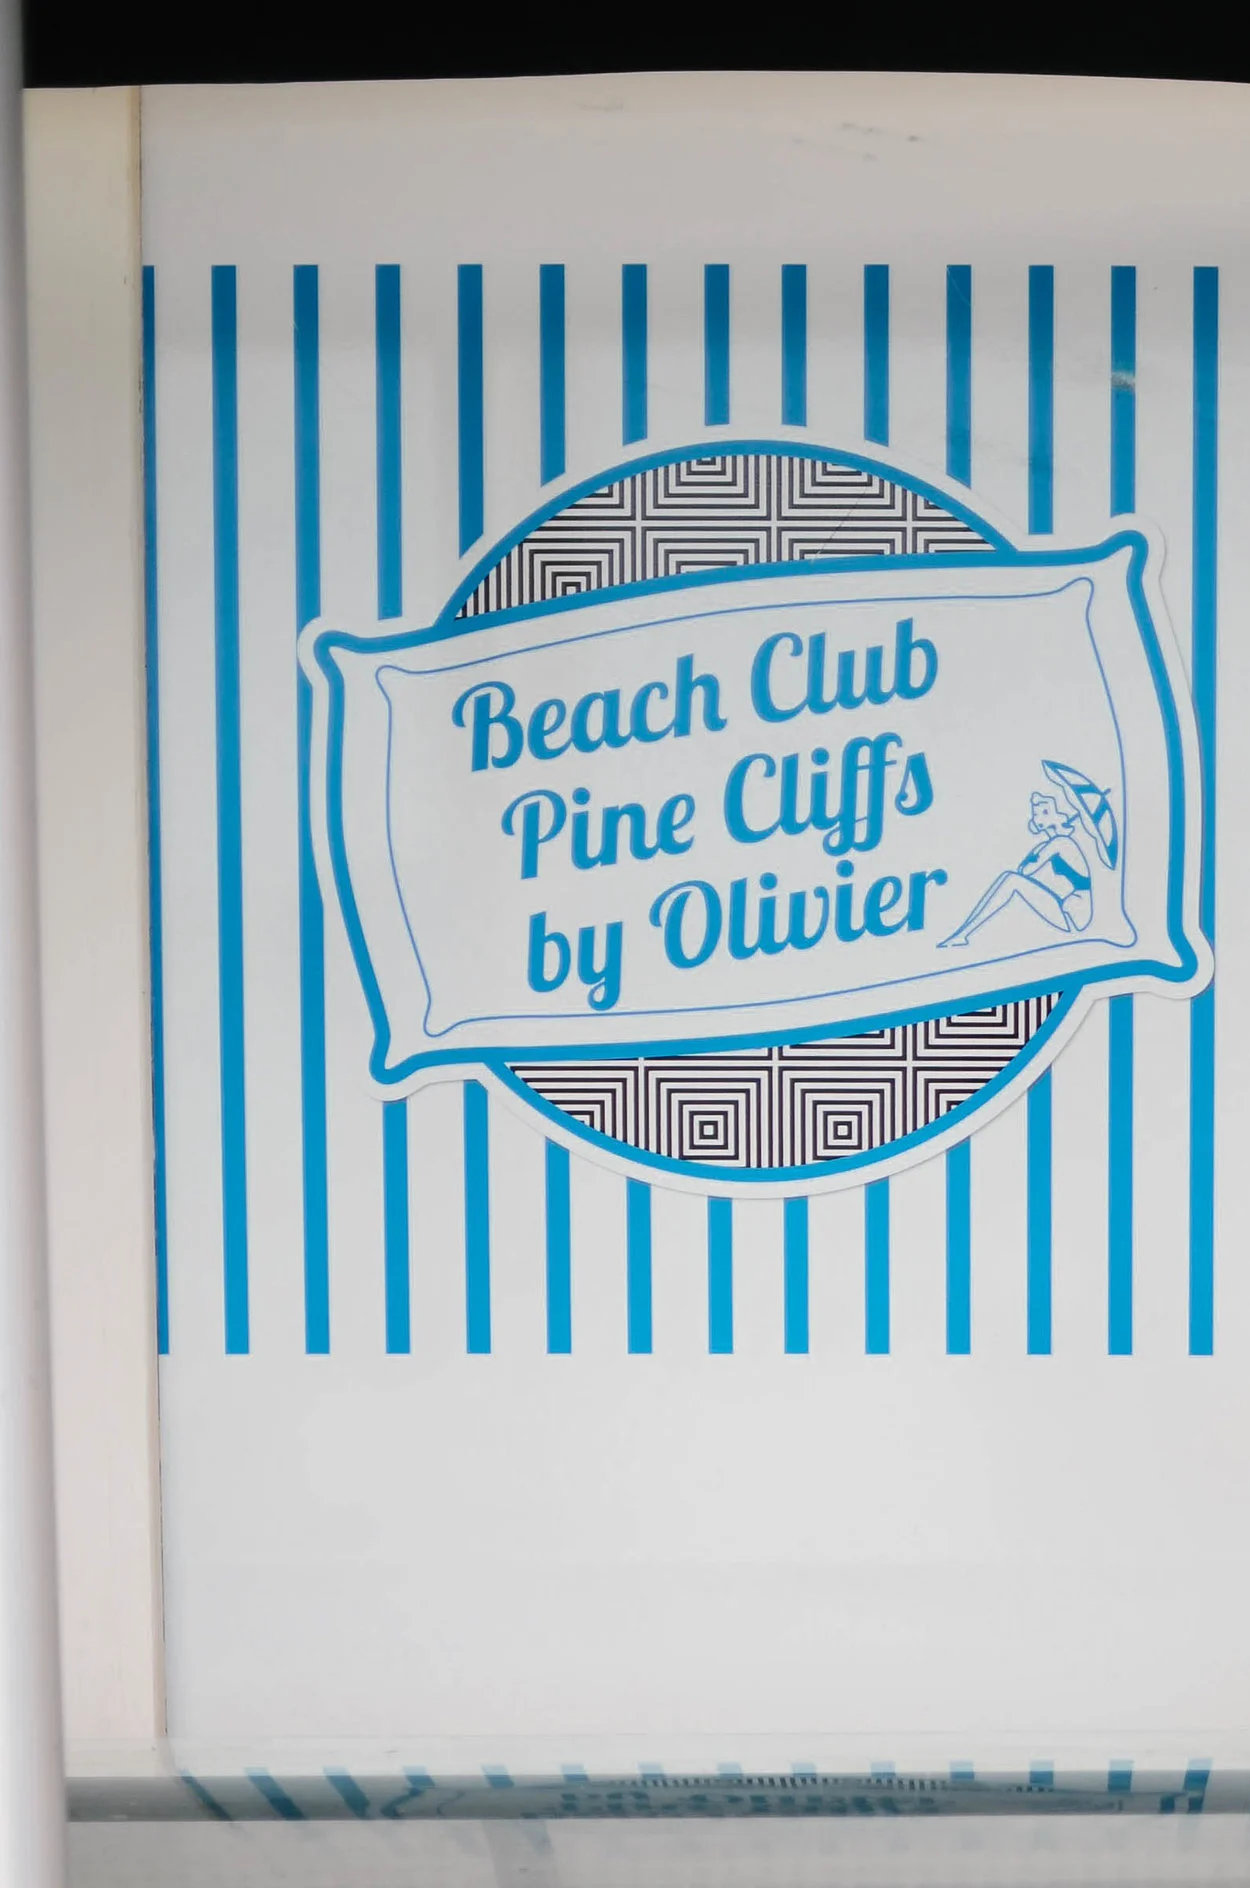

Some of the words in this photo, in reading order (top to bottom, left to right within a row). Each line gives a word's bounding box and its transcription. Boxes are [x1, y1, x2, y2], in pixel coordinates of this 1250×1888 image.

[452, 655, 727, 772] Beach
[751, 619, 938, 723] Club
[502, 788, 695, 879] Pine
[724, 733, 933, 857] Cliffs
[528, 912, 622, 1011] by
[650, 860, 947, 969] Olivier
